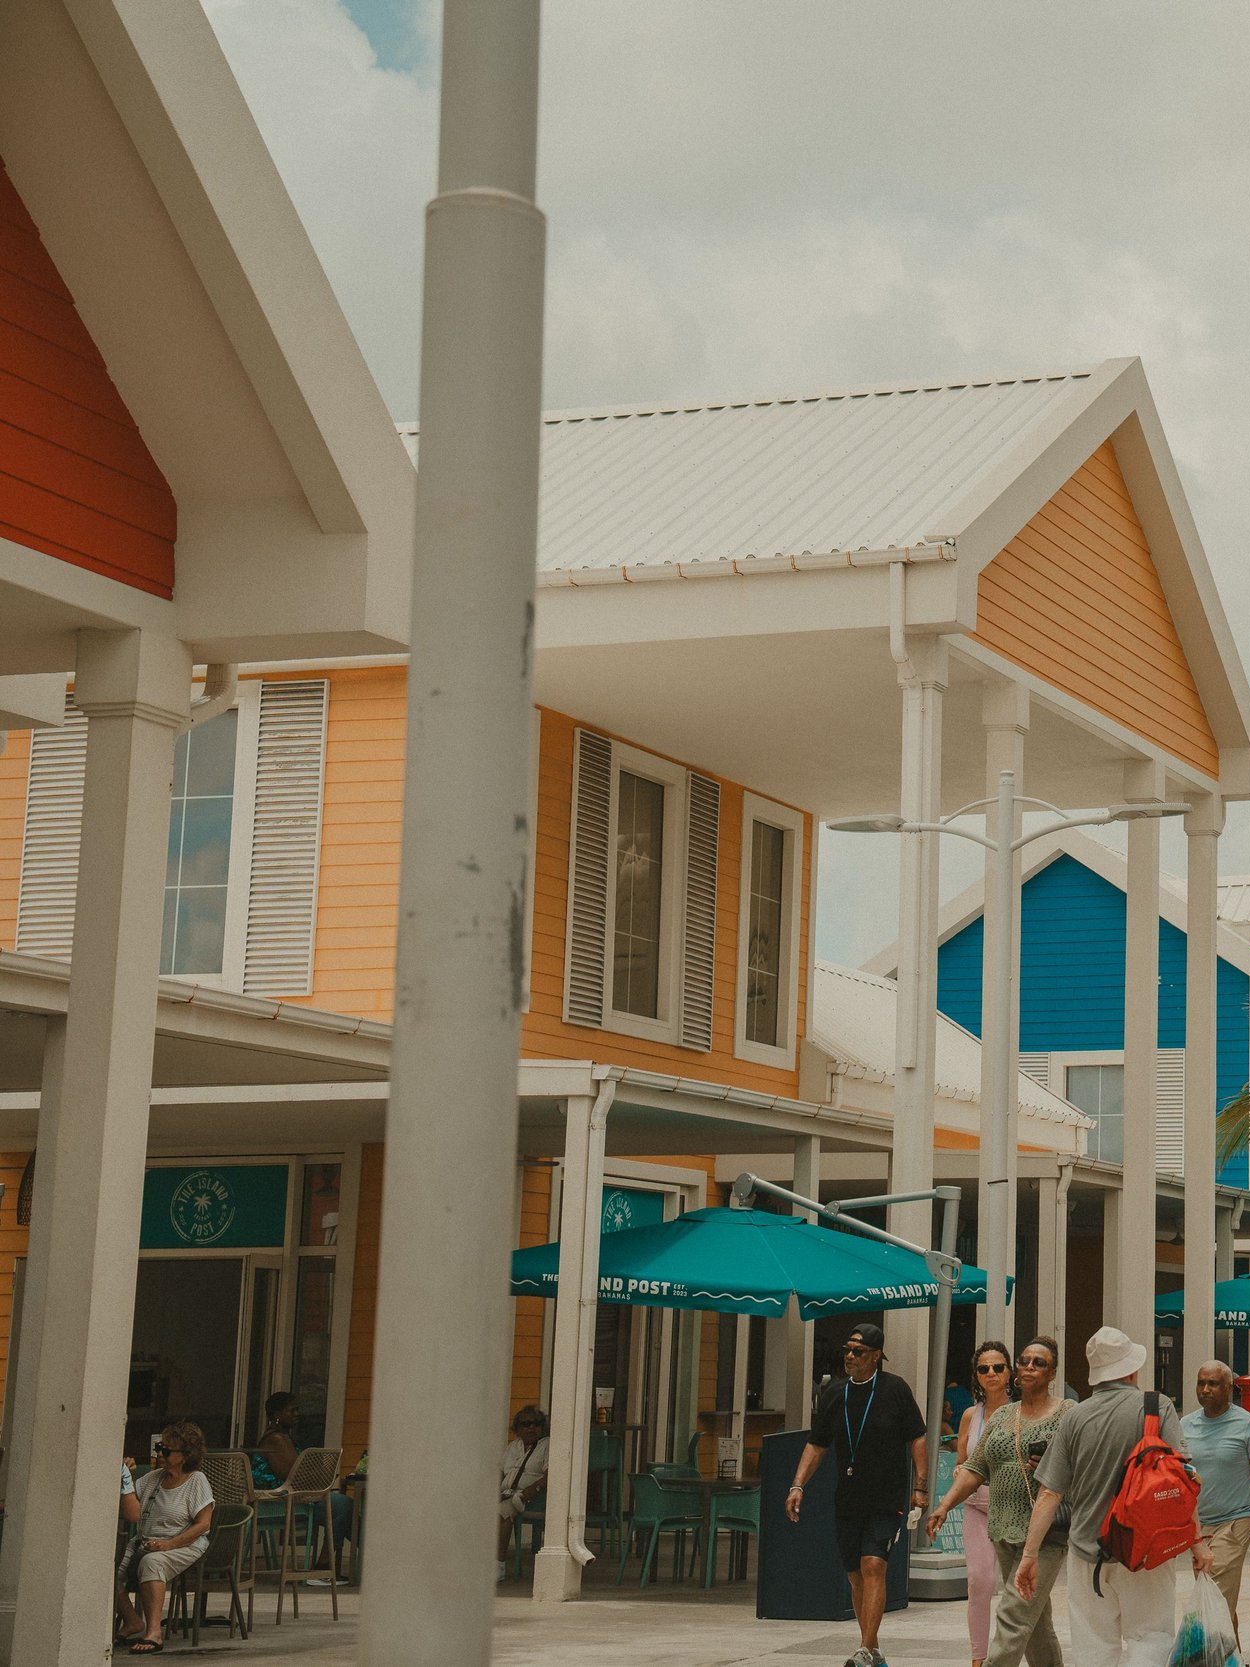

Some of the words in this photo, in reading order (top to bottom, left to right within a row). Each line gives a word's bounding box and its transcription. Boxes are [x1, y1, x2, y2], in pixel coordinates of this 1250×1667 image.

[178, 1183, 195, 1203] THE
[198, 1178, 229, 1200] ISLAND
[190, 1221, 214, 1236] POST
[542, 1273, 559, 1282] THE
[628, 1279, 671, 1295] POST
[867, 1287, 881, 1295] THE
[880, 1283, 922, 1299] ISLAND
[923, 1283, 940, 1296] PO
[598, 1291, 631, 1300] BAHAMAS
[906, 1297, 929, 1305] BAHAMAS
[1214, 1310, 1247, 1321] AND
